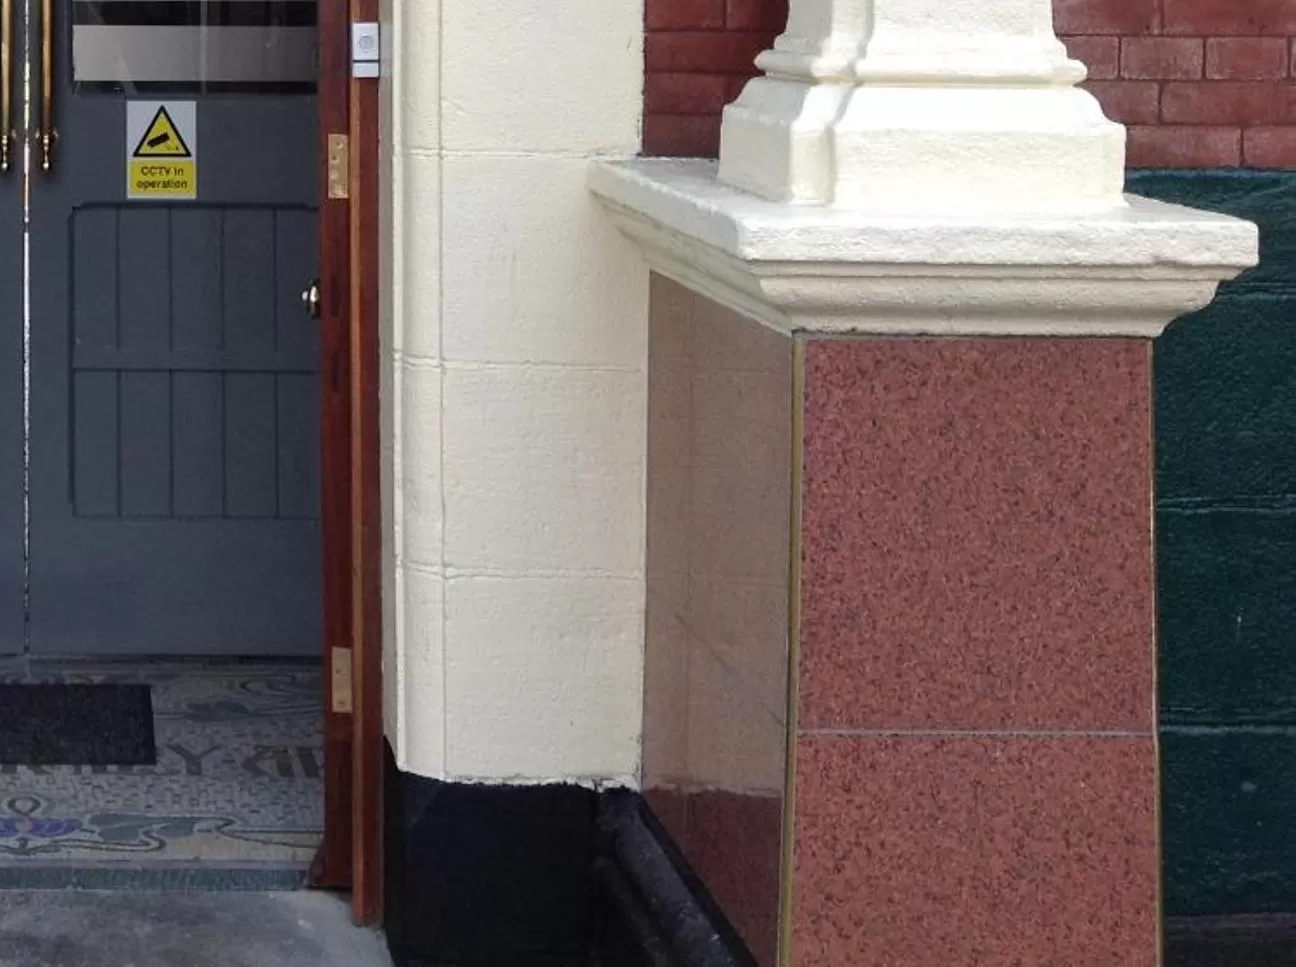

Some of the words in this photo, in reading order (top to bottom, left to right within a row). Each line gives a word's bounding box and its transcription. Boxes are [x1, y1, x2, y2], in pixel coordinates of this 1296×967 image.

[141, 166, 169, 176] CCTV
[174, 166, 184, 176] in
[136, 180, 188, 190] operation
